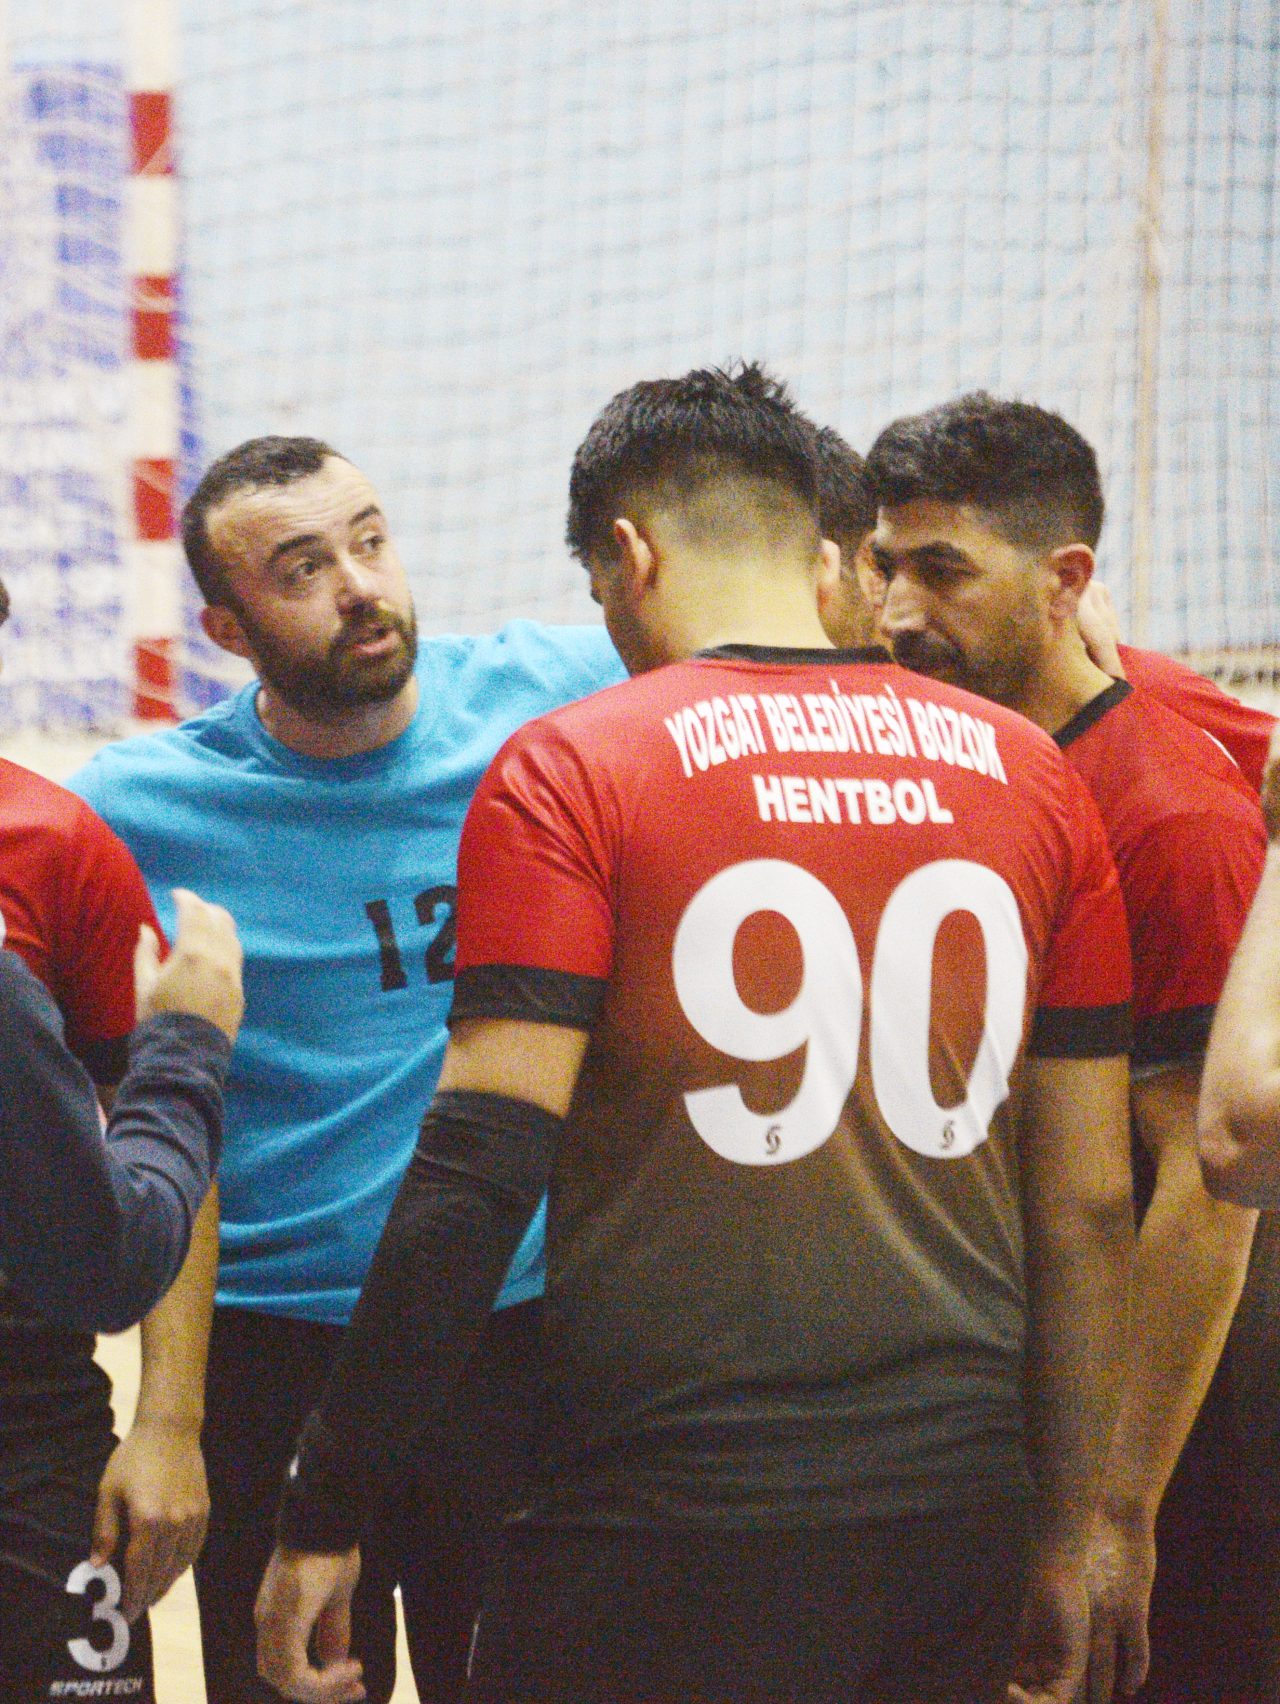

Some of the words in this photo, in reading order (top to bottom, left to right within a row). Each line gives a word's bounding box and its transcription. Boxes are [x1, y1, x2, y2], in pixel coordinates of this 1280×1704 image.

[664, 693, 768, 779] YOZGAT
[758, 677, 918, 759] BELEDİYESİ
[905, 697, 1009, 786] BOZOK
[751, 773, 955, 825] HENTBOL
[364, 885, 458, 993] 12
[671, 857, 1029, 1167] 90
[65, 1559, 131, 1673] 3
